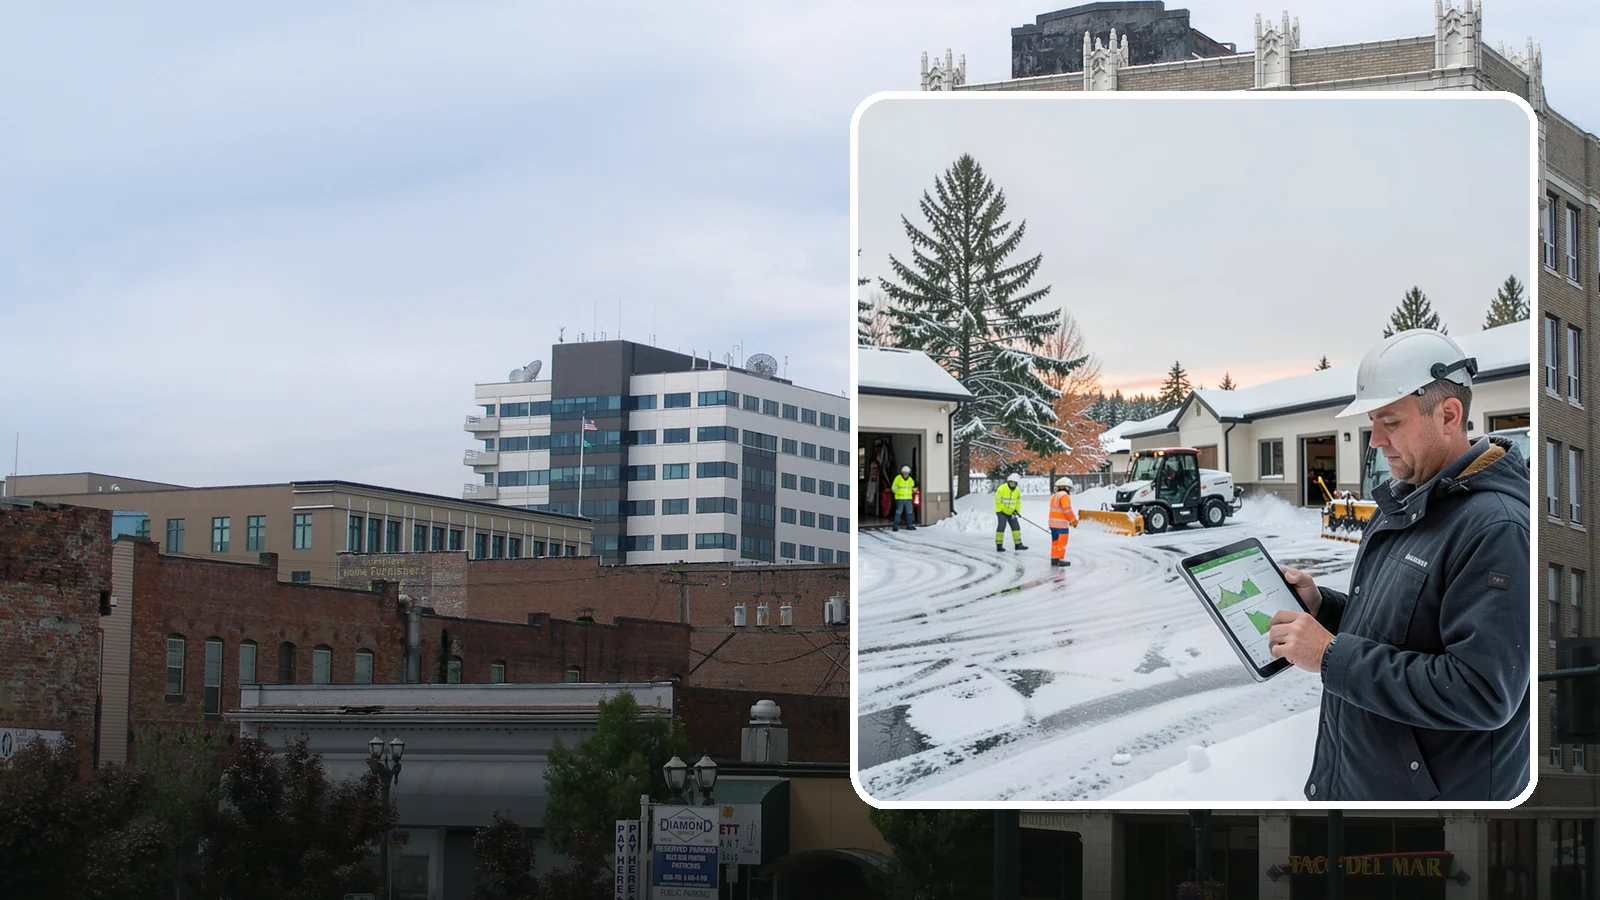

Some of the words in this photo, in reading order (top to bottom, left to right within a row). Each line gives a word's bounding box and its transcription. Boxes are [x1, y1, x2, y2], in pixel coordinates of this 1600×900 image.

[370, 566, 427, 577] Furnishers
[660, 818, 713, 832] DIAMOND
[1022, 815, 1071, 828] BUILDING
[617, 825, 625, 853] PAY
[628, 825, 637, 853] PAY
[656, 845, 688, 853] RESERVED
[721, 851, 739, 862] Soup
[671, 862, 701, 870] PATRONS
[1289, 855, 1329, 875] TAC
[1345, 856, 1385, 875] DEL
[1392, 857, 1443, 877] MAR
[616, 856, 625, 893] HERE
[627, 856, 636, 893] HERE
[660, 888, 682, 897] PUBLIC
[683, 889, 710, 898] PARKING
